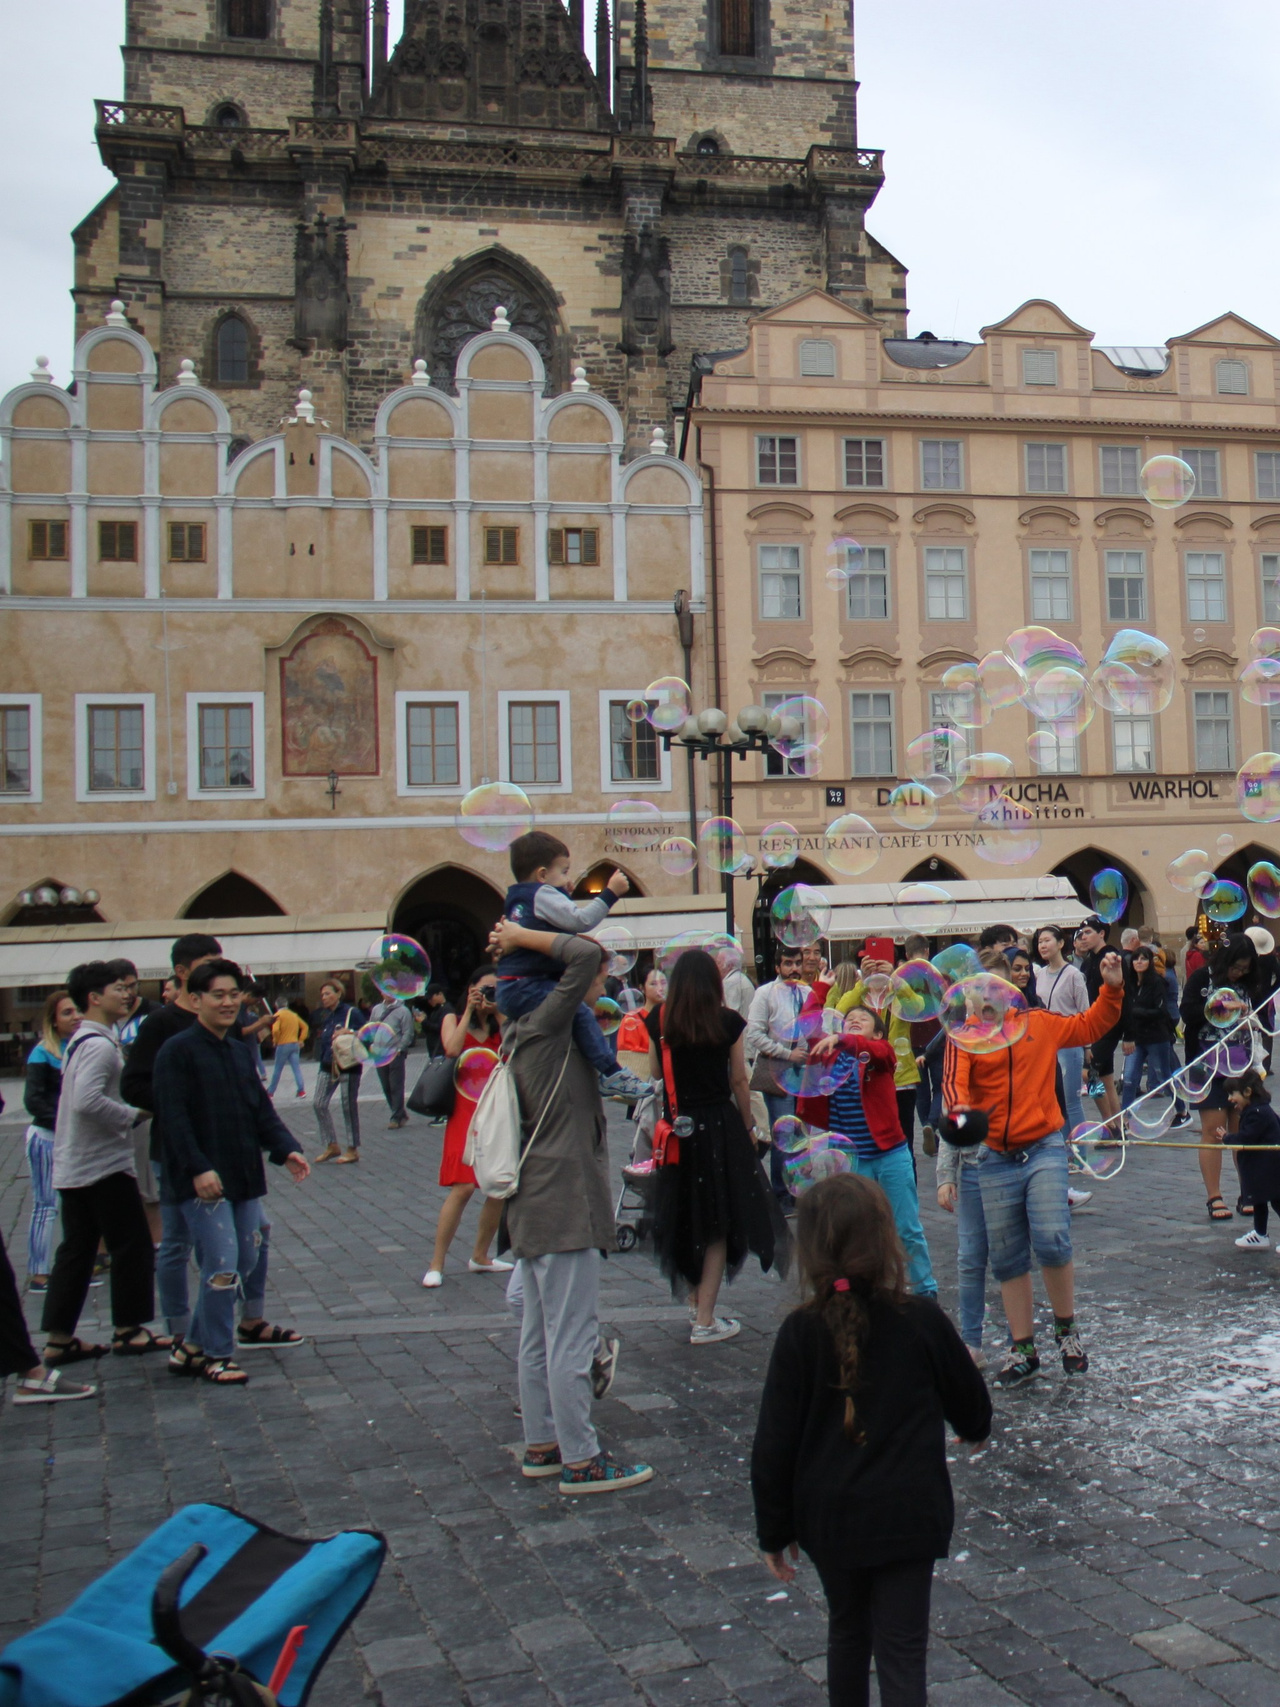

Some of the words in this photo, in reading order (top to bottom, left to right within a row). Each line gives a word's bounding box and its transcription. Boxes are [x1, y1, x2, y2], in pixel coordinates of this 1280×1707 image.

[877, 787, 925, 806] DALI
[988, 783, 1070, 802] MUCHA
[1128, 780, 1219, 799] WARHOL
[978, 804, 1085, 820] exhibition
[603, 826, 675, 836] RISTORANTE
[643, 842, 682, 852] ITALIA
[758, 836, 874, 852] RESTAURANT
[879, 832, 921, 849] CAFÉ
[926, 835, 938, 848] U
[941, 832, 987, 848] TÝNA
